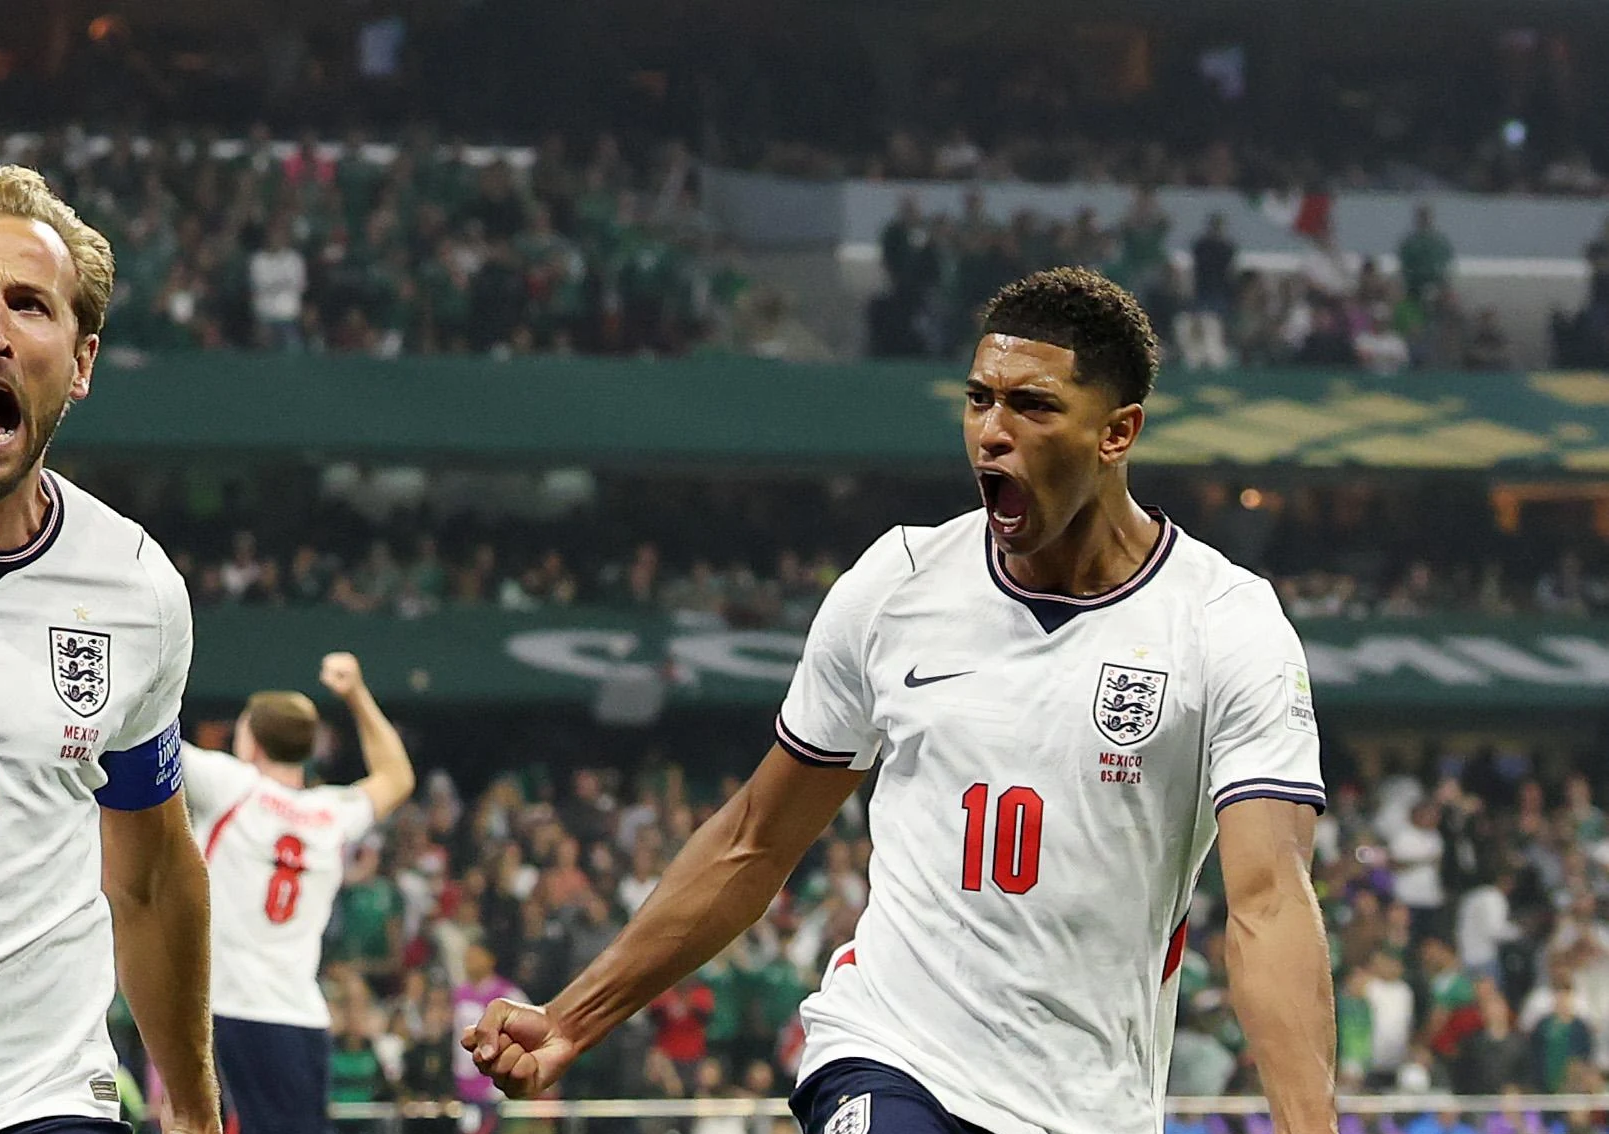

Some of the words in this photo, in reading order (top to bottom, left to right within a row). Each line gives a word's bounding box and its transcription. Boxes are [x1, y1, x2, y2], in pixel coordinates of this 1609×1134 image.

[63, 725, 99, 743] MEXICO
[1099, 752, 1142, 768] MEXICO
[1100, 769, 1142, 785] 05.07.26
[961, 782, 1044, 895] 10
